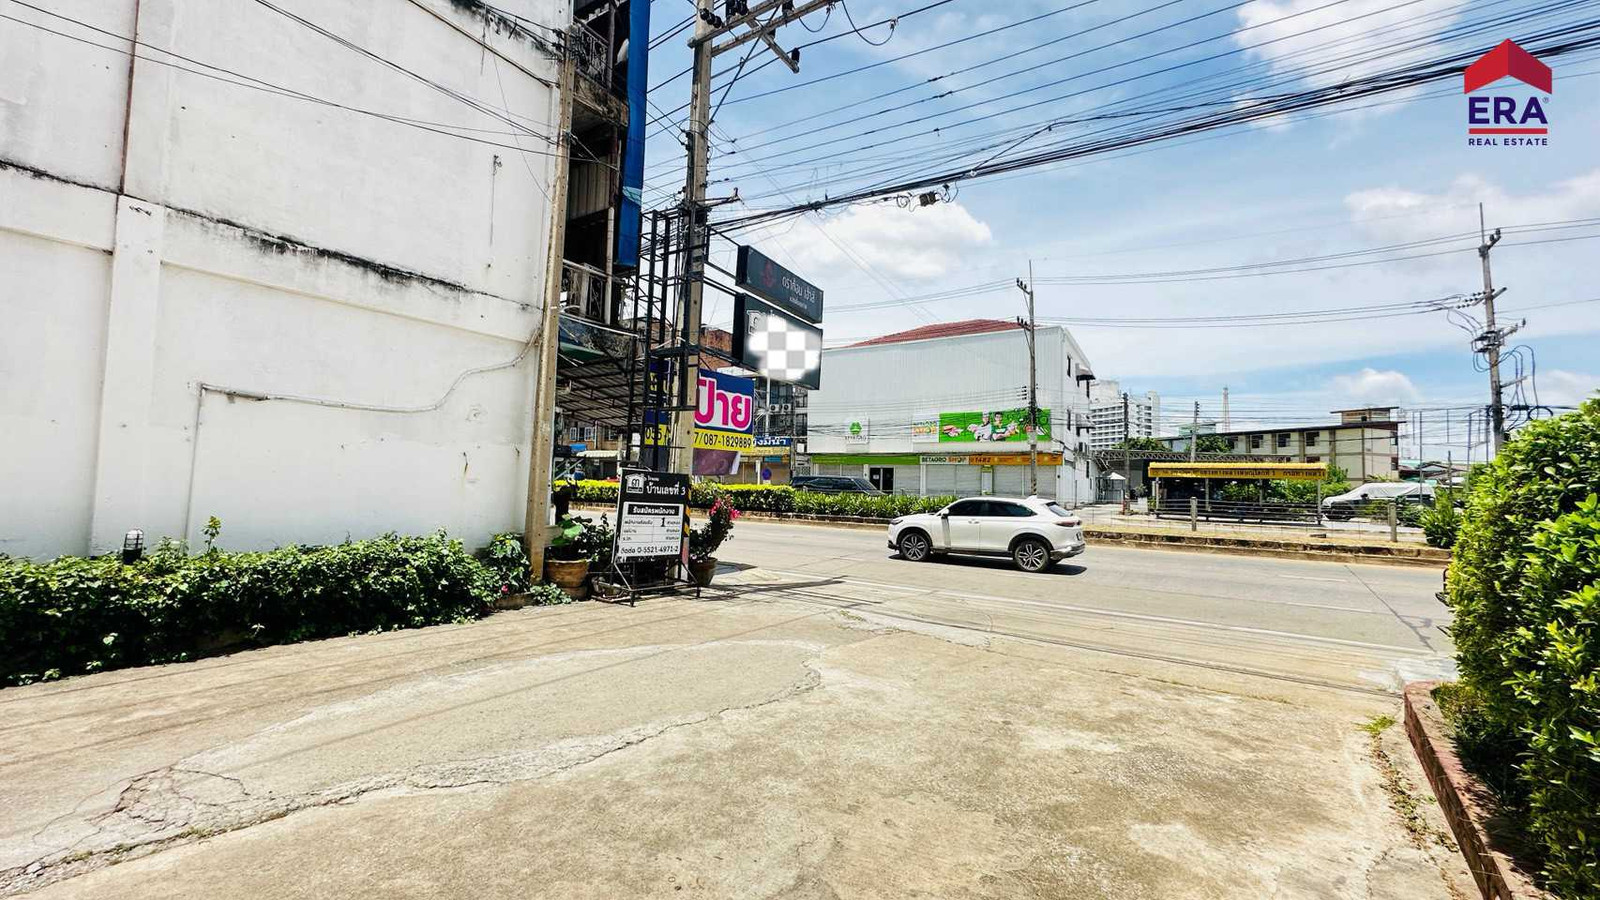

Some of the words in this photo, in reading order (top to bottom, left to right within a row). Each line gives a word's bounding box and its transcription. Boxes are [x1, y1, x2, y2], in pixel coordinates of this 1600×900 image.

[646, 481, 680, 495] บ้านเลขที่
[680, 486, 686, 495] 3
[660, 517, 666, 527] 1
